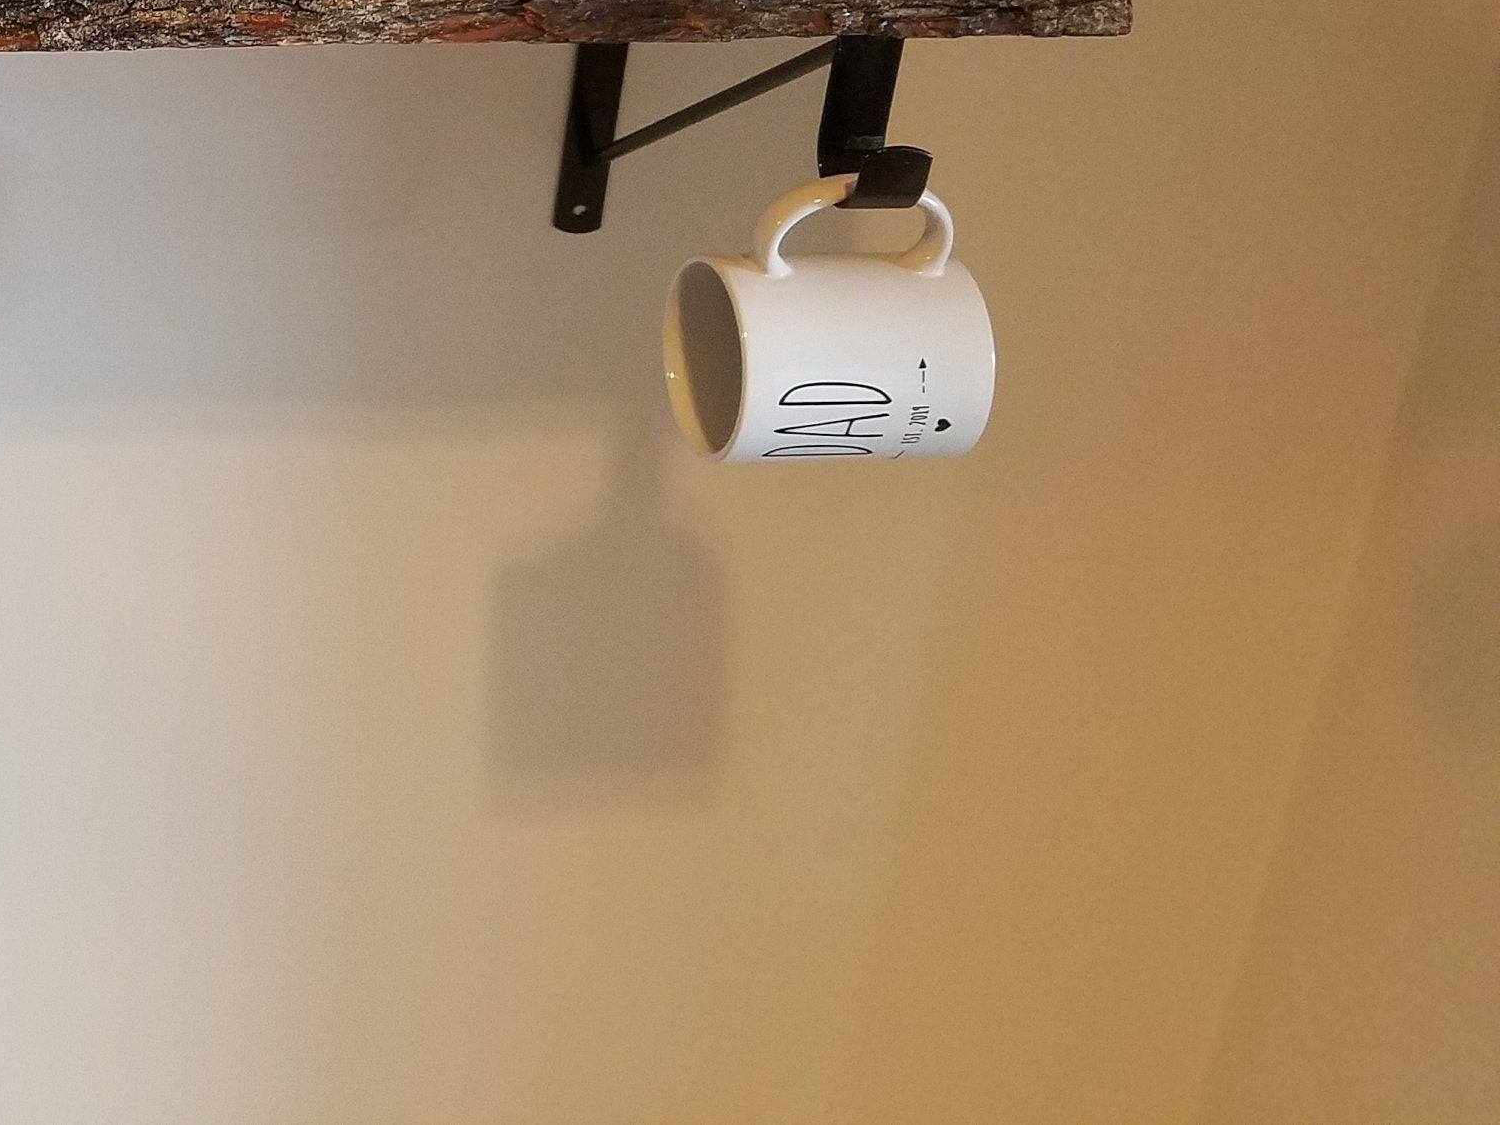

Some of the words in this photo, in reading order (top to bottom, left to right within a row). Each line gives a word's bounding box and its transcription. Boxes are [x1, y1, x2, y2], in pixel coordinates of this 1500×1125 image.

[762, 382, 892, 457] DAD
[909, 405, 930, 426] 2019
[900, 429, 923, 444] EST.
